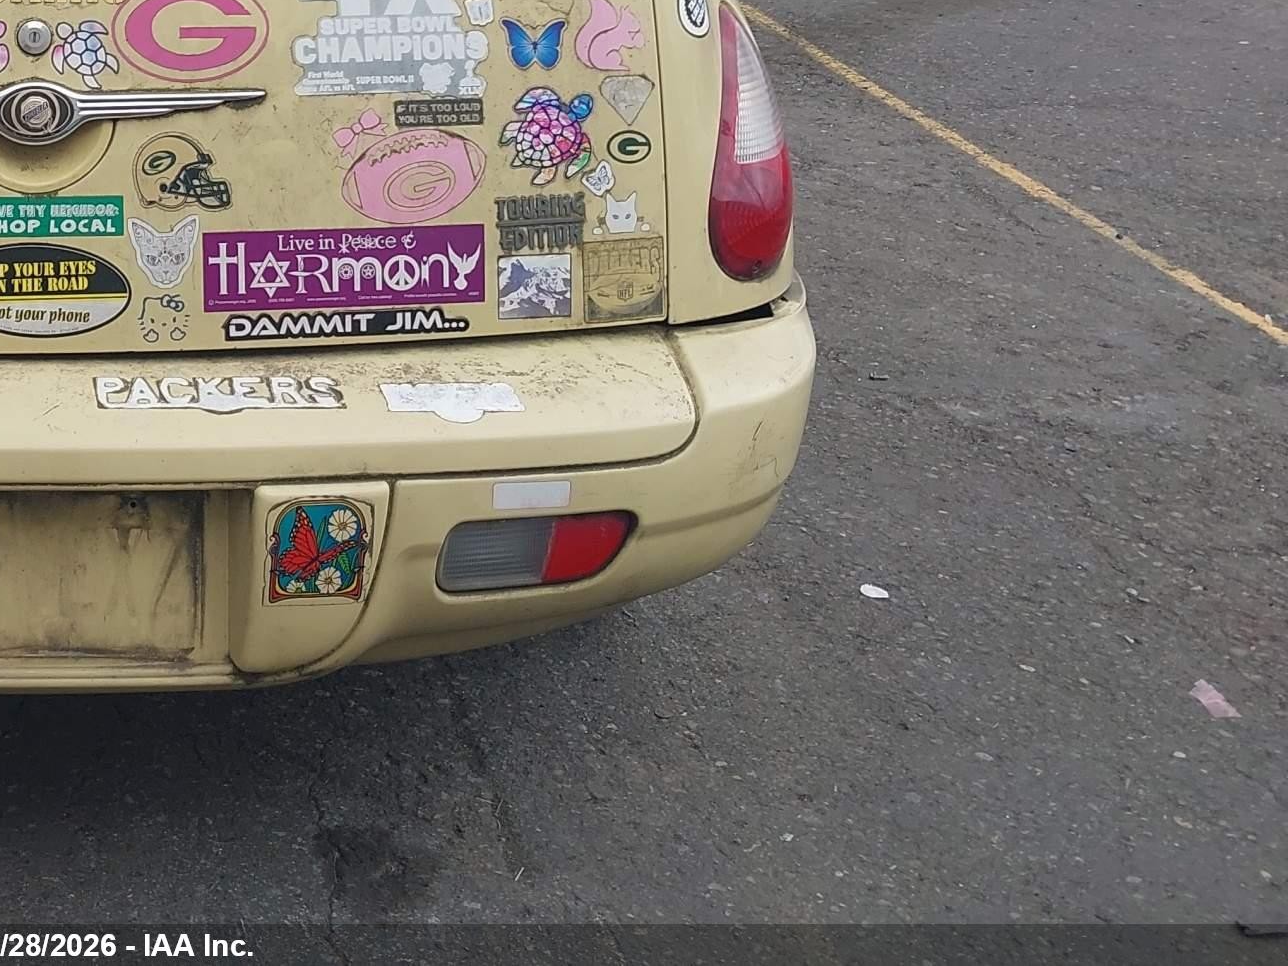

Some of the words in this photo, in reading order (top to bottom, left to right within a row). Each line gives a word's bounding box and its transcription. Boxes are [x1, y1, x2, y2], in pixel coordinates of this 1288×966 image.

[318, 17, 392, 35] SUPER
[396, 16, 460, 34] BOWL
[294, 32, 489, 65] CHAMPIONS
[355, 75, 382, 85] SUPER
[430, 103, 452, 112] TOO
[454, 103, 481, 112] LOUD
[436, 114, 458, 123] TOO
[459, 113, 481, 122] OLD
[18, 205, 47, 218] THY
[495, 192, 585, 221] TOURING
[49, 219, 116, 233] LOCAL
[278, 234, 314, 251] Live
[318, 234, 335, 250] in
[499, 224, 585, 251] EDITION
[13, 262, 55, 277] YOUR
[59, 261, 96, 275] EYES
[12, 277, 43, 293] THE
[47, 276, 89, 291] ROAD
[14, 308, 47, 323] your
[48, 307, 91, 324] phone
[229, 313, 376, 337] DAMMIT
[385, 310, 466, 332] JIM...
[94, 376, 345, 410] PACKERS
